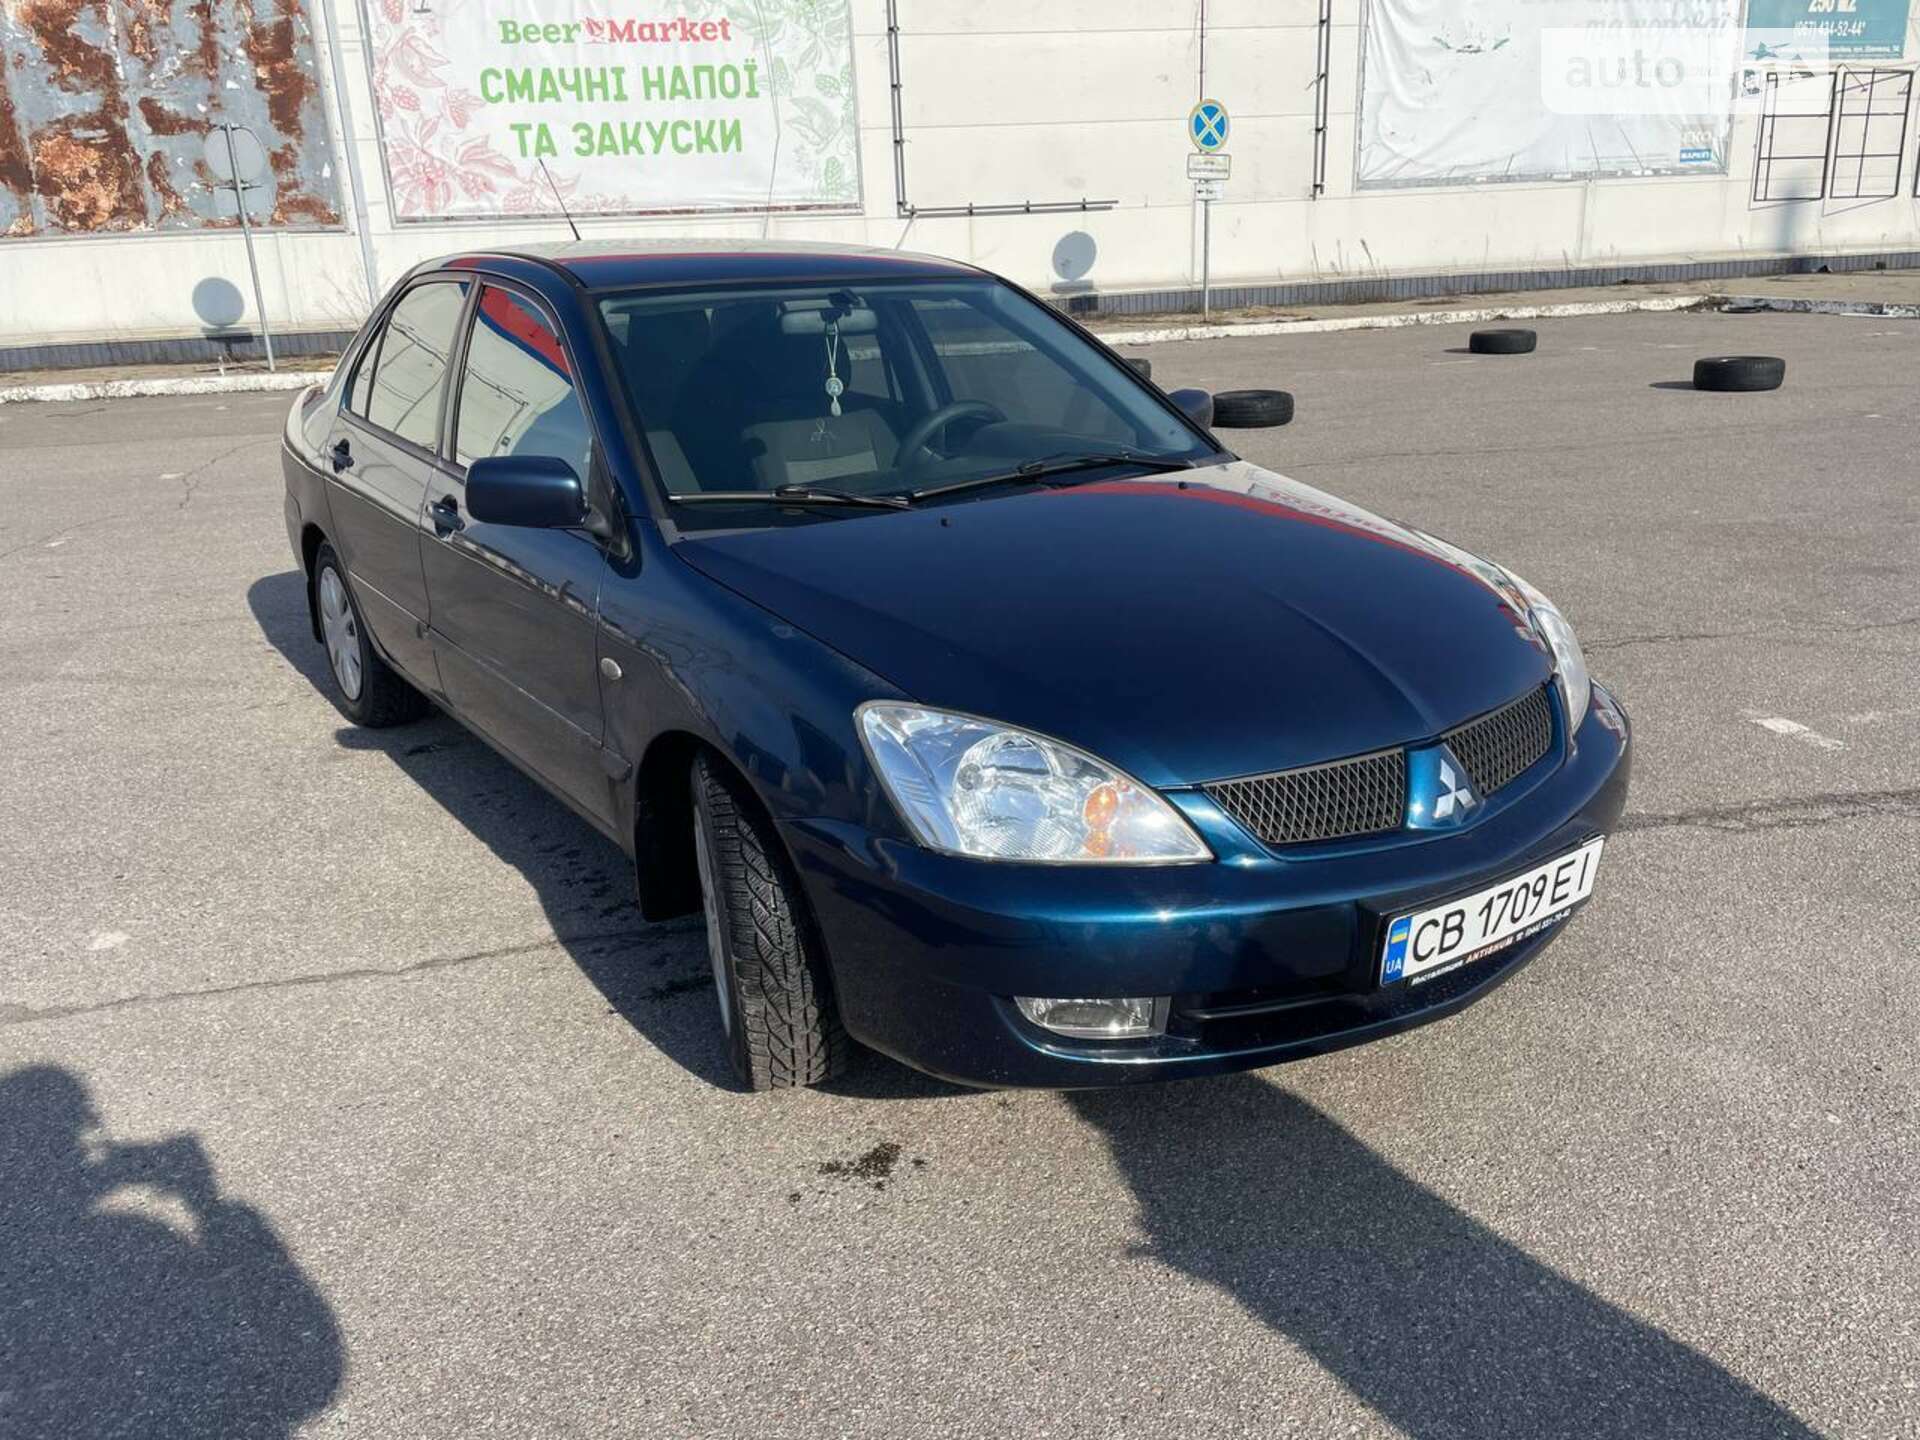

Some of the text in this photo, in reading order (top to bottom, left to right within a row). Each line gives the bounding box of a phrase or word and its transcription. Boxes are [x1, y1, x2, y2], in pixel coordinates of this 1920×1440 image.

[498, 17, 732, 45] Beer Market
[480, 58, 759, 104] СМАЧНІ НАПОЇ
[509, 119, 742, 157] ТА ЗАКУСКИ
[1412, 908, 1466, 962] CB
[1478, 873, 1548, 938] 1709
[1386, 958, 1402, 974] UA
